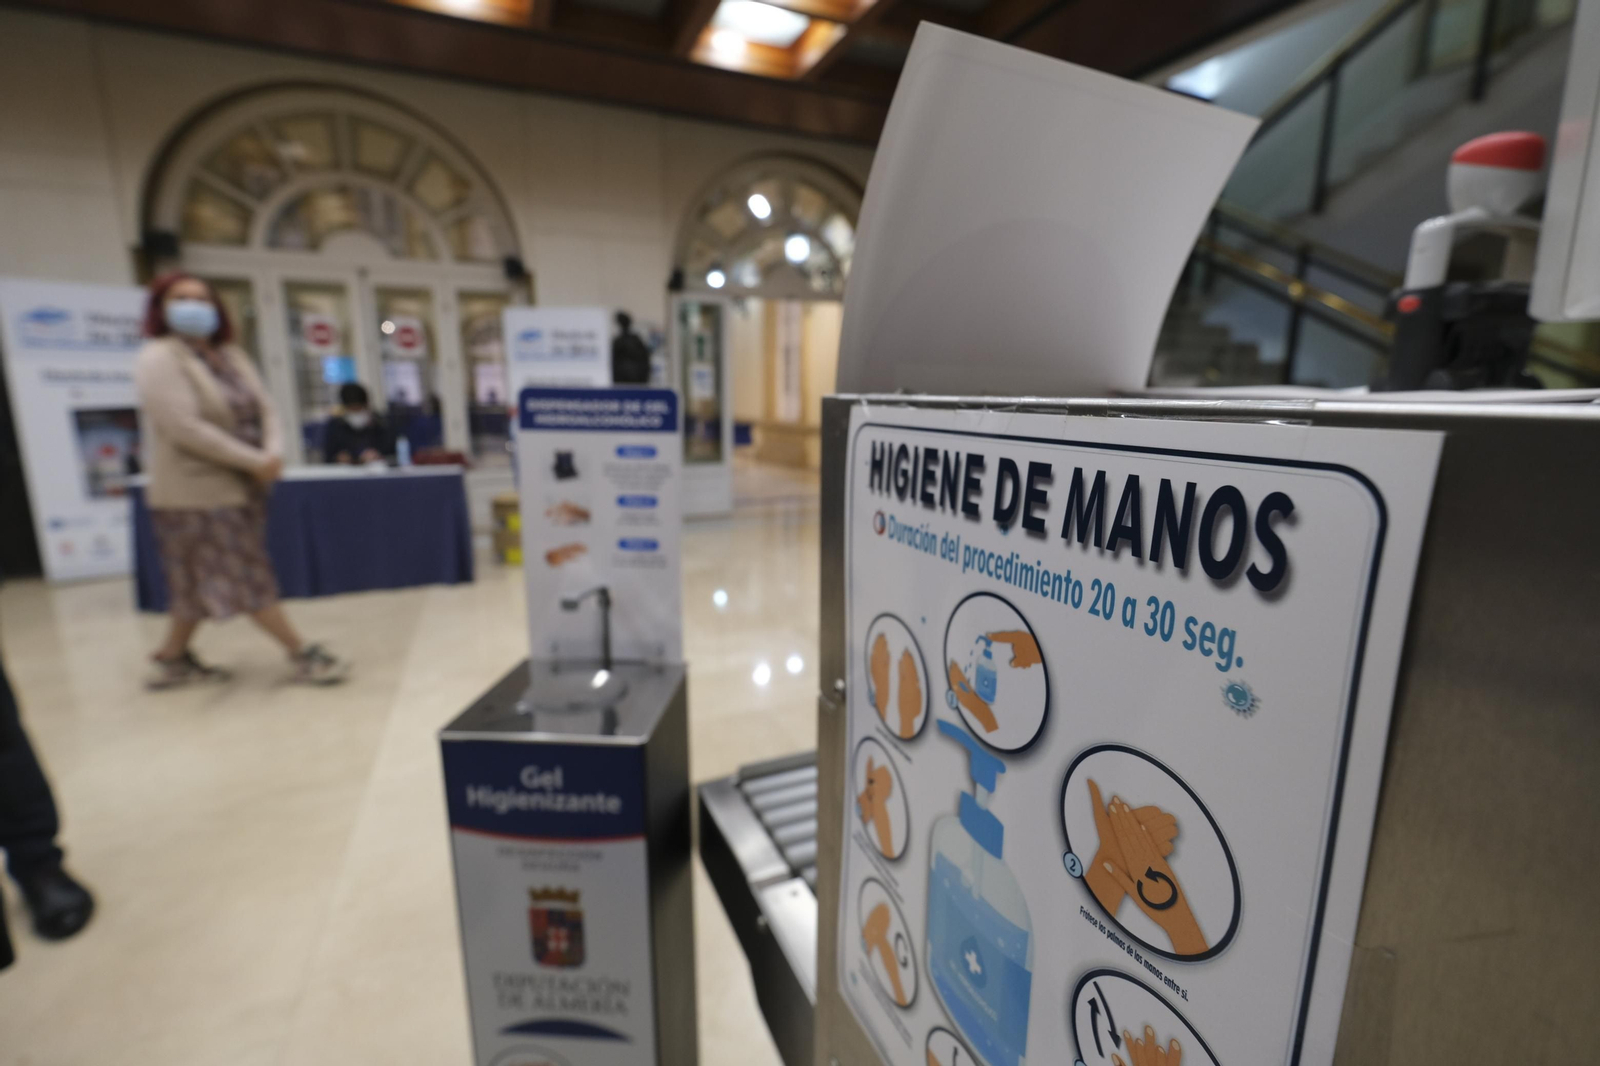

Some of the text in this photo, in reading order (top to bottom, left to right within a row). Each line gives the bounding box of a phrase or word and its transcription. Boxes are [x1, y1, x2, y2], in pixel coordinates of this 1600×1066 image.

[869, 440, 1296, 593] HIGIENE DE MANOS
[887, 513, 1244, 673] Duración del procedimiento 20 a 30 seg.
[465, 784, 623, 815] Higienizante
[519, 764, 564, 789] Gel
[1097, 919, 1107, 936] las
[1106, 928, 1126, 952] palmas
[1126, 943, 1135, 958] de
[1134, 948, 1143, 966] las
[1143, 958, 1163, 982] manos
[1163, 975, 1181, 996] entre
